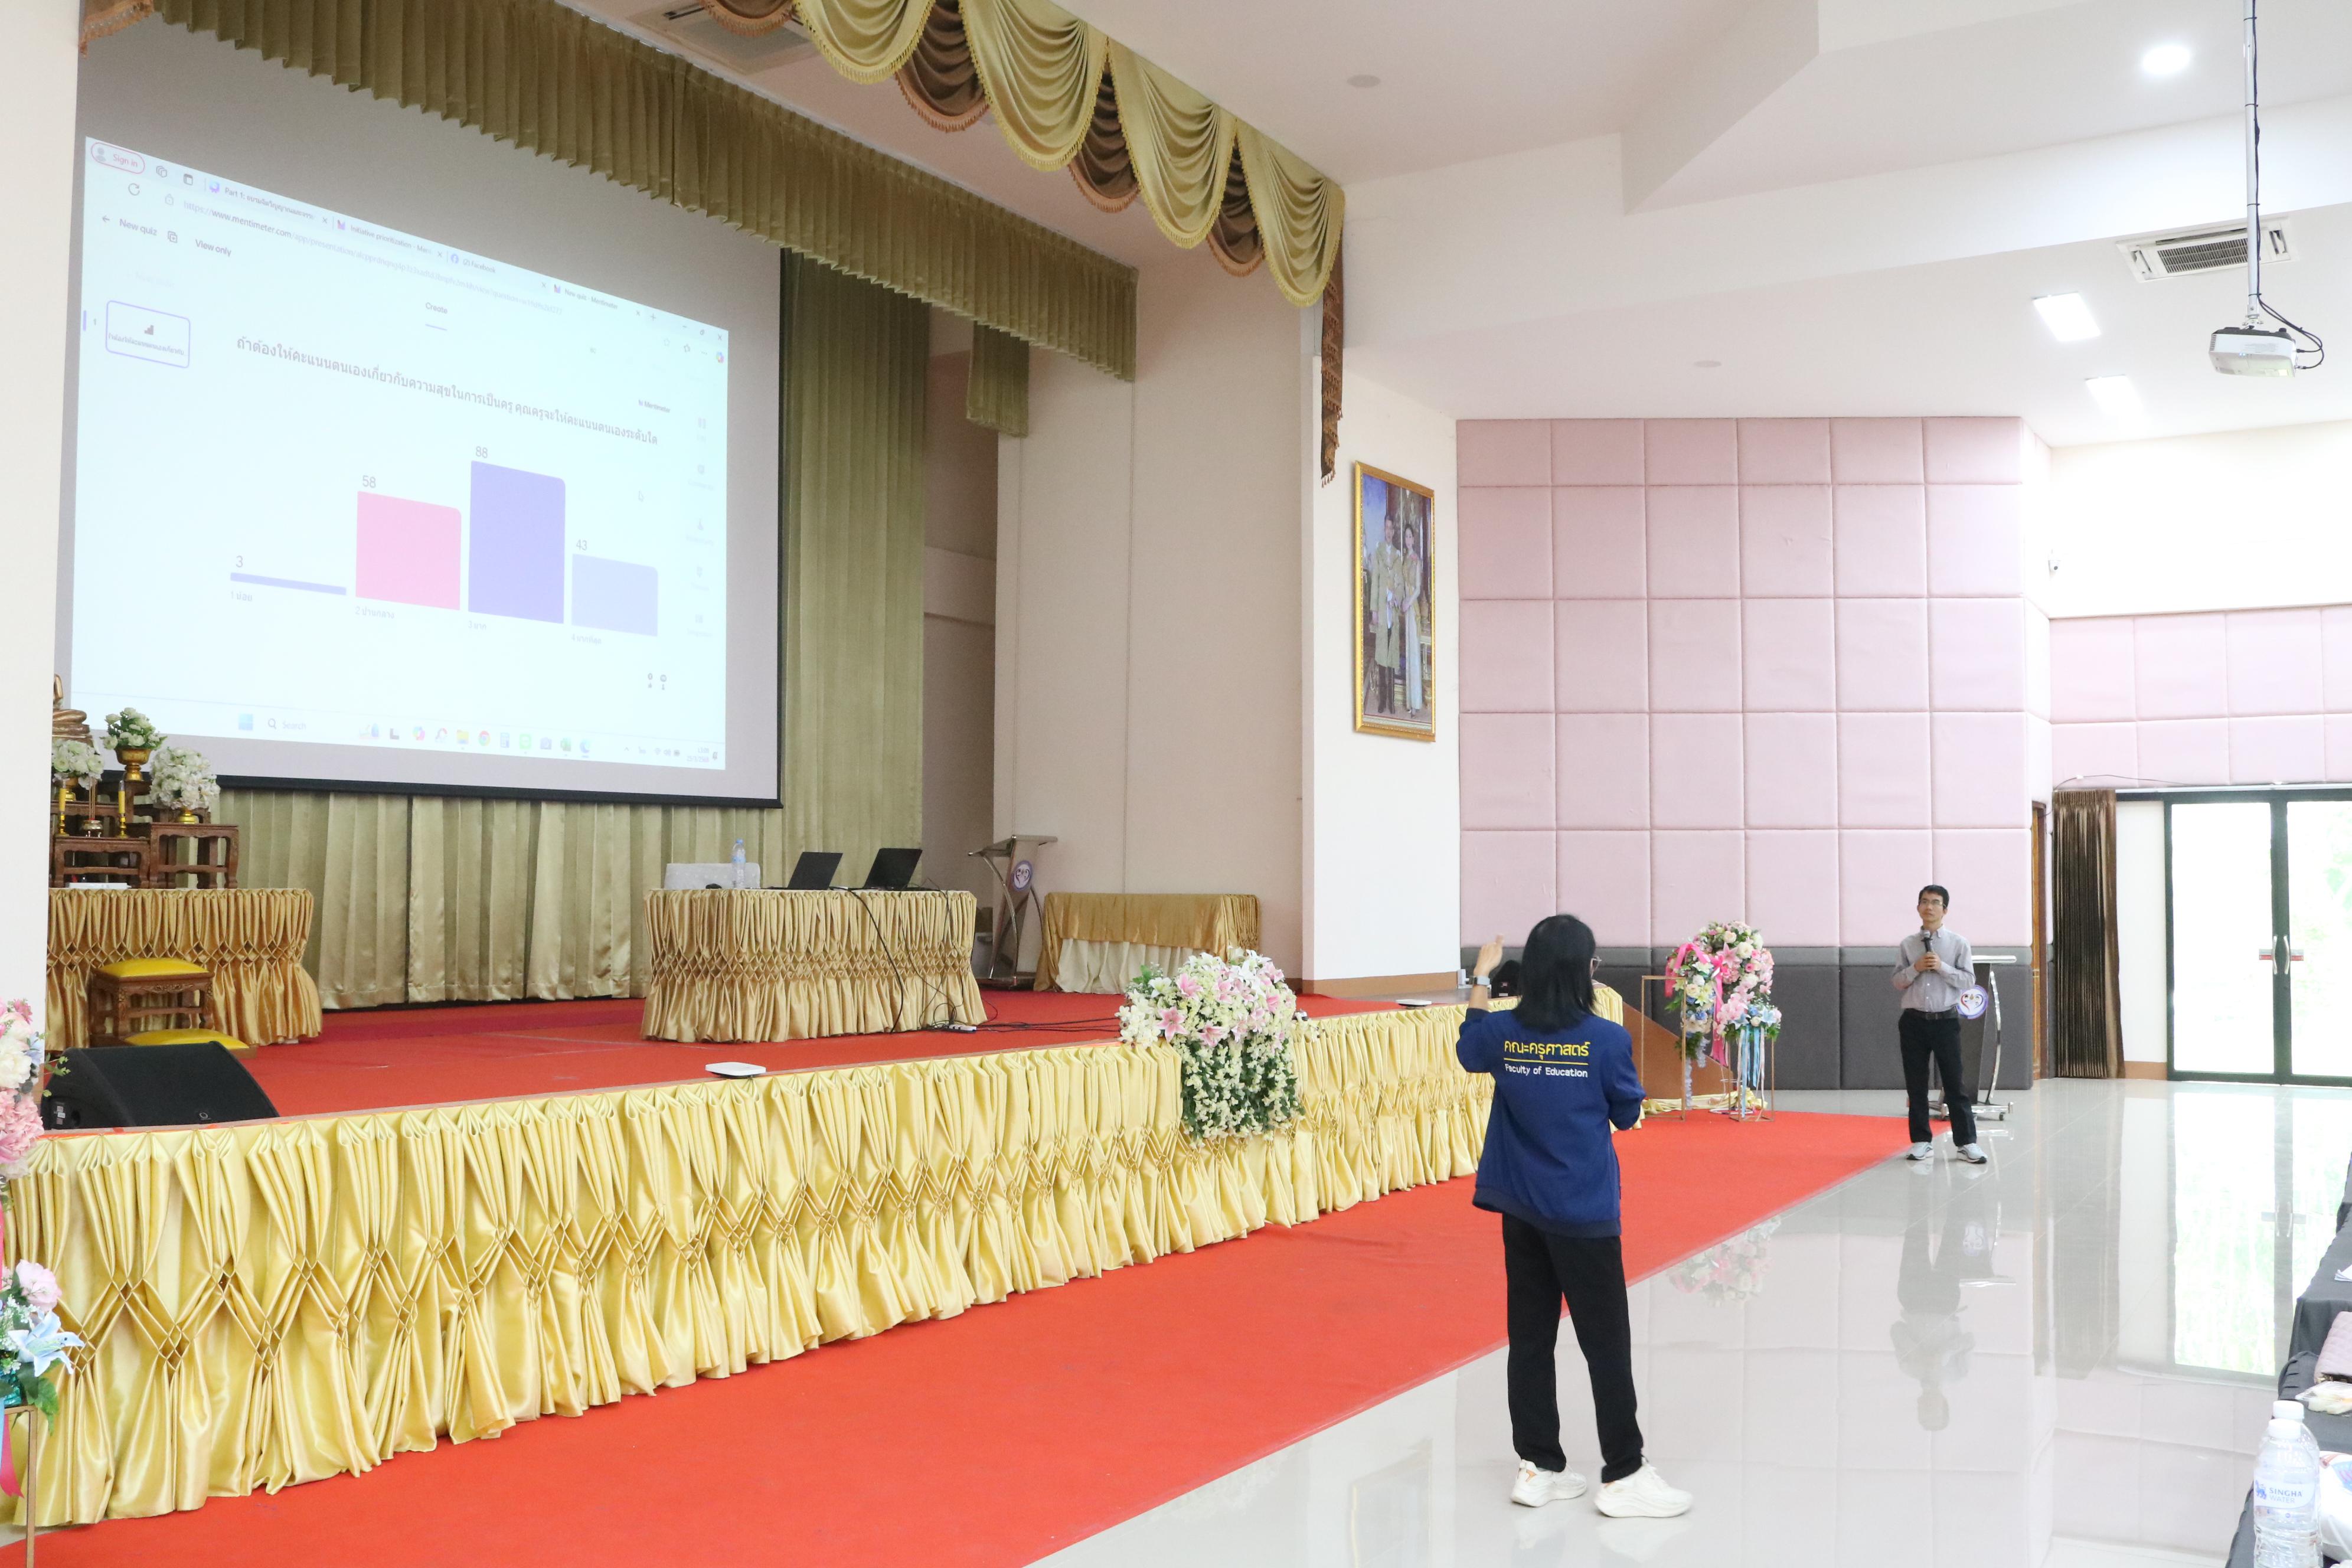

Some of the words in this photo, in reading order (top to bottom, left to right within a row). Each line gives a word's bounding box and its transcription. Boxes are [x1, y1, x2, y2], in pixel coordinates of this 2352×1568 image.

[113, 153, 128, 166] Sign
[130, 158, 139, 168] in
[224, 187, 238, 198] Part
[119, 218, 139, 230] New
[140, 224, 157, 236] quiz
[195, 239, 214, 251] View
[215, 244, 232, 257] only
[350, 224, 375, 237] Initiative
[376, 234, 411, 249] prioritization
[471, 261, 496, 273] Facebook
[425, 302, 448, 315] Create
[475, 446, 488, 458] 88
[362, 475, 377, 489] 58
[576, 539, 588, 551] 43
[236, 555, 244, 569] 3
[282, 720, 306, 731] Search
[1504, 1040, 1591, 1060] คณะครุศาสตร์
[1505, 1063, 1531, 1076] Faculty
[1533, 1066, 1542, 1075] of
[1545, 1067, 1588, 1078] Education
[2269, 1487, 2302, 1498] SINGHA
[2269, 1495, 2295, 1504] WATER
